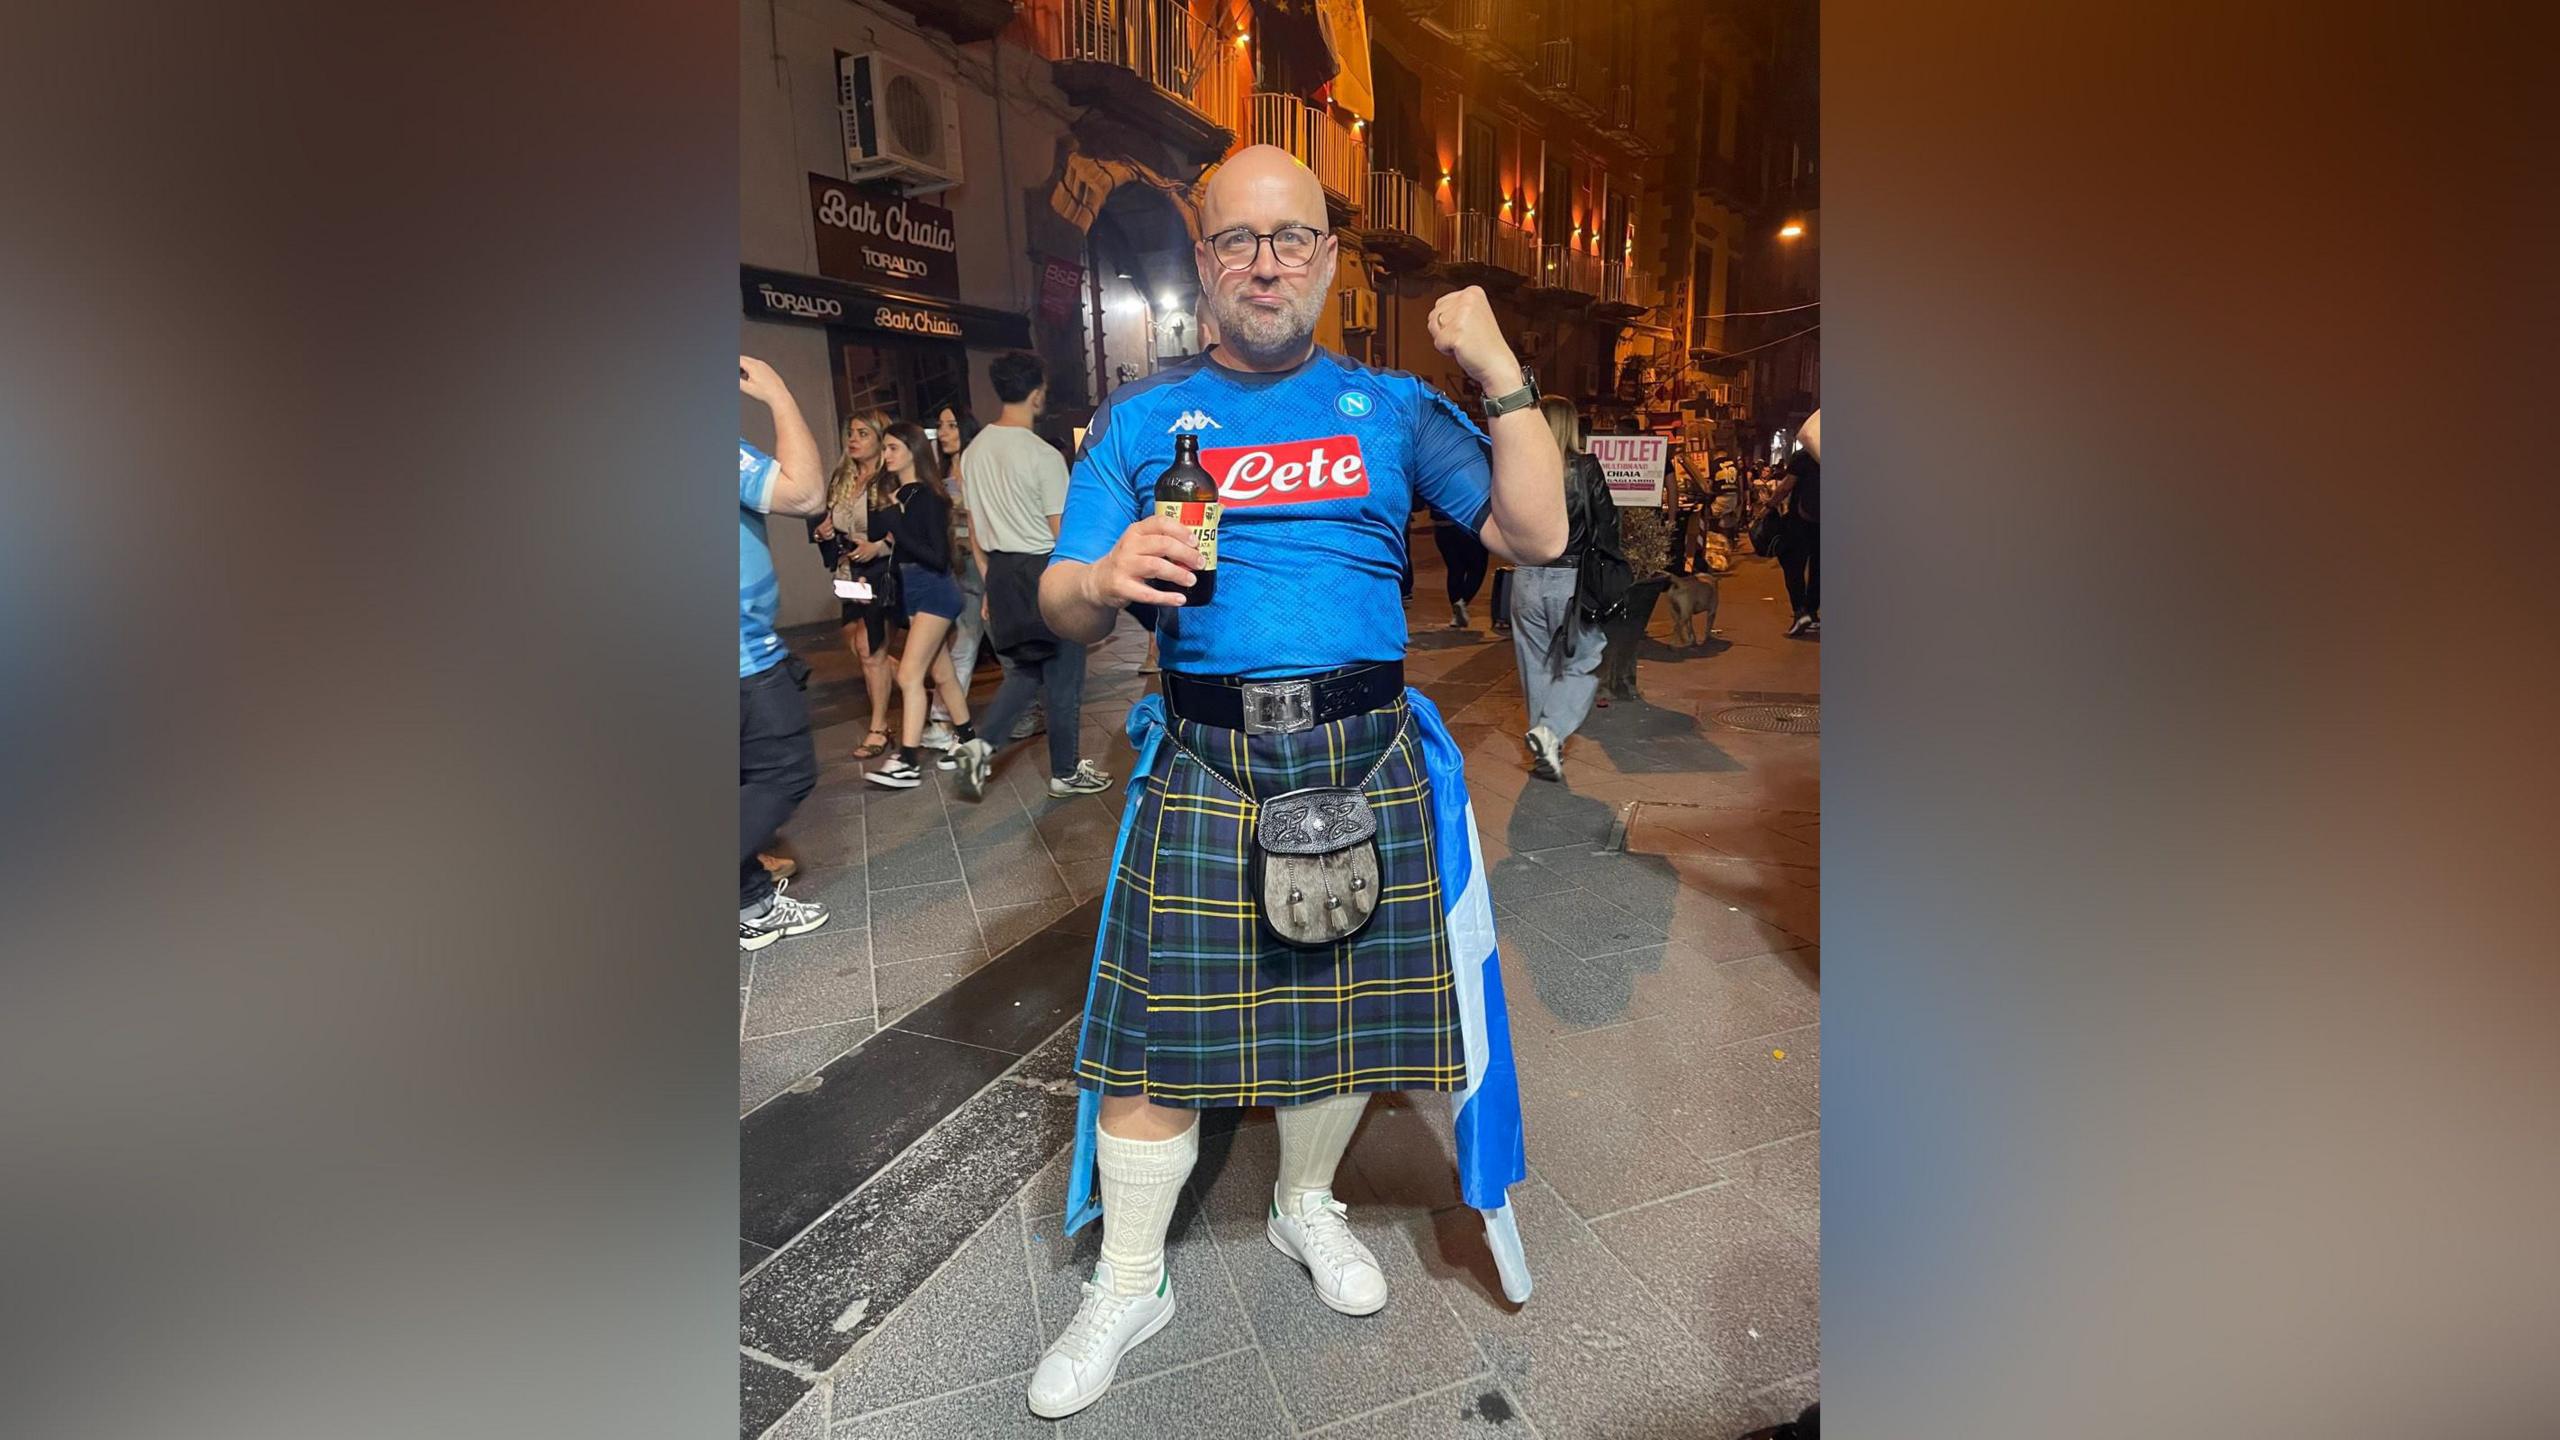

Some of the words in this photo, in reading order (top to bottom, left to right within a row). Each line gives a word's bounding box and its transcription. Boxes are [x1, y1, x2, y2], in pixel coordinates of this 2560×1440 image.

[818, 189, 881, 235] Bar
[885, 202, 955, 253] Chiaia
[862, 248, 927, 275] TORALDO
[1044, 264, 1079, 287] B&B
[760, 287, 842, 315] TORALDO
[874, 307, 913, 328] Bar
[914, 311, 962, 336] Chiaia
[1346, 397, 1365, 412] N
[1591, 440, 1662, 461] OUTLET
[1218, 447, 1363, 500] Lete
